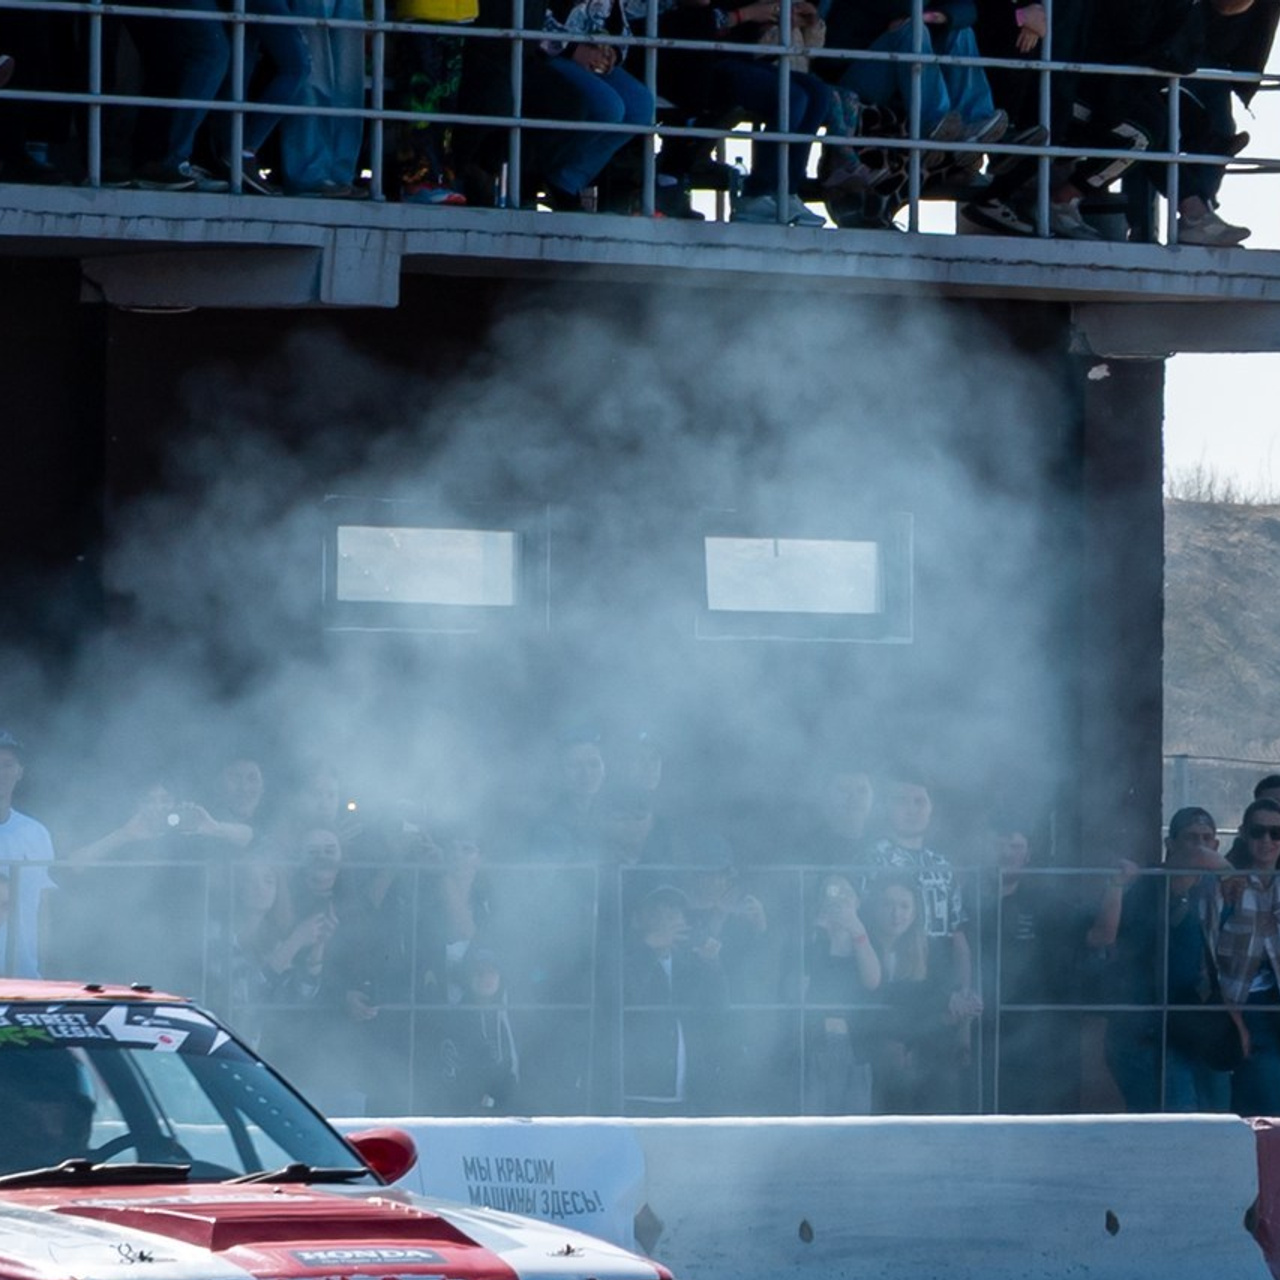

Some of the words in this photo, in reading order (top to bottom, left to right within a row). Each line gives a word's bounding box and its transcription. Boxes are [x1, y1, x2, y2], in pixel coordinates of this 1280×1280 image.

[15, 1013, 89, 1027] STREET
[47, 1025, 111, 1040] LEGAL
[462, 1156, 492, 1183] МЫ
[494, 1157, 556, 1186] КРАСИМ
[468, 1185, 537, 1214] МАШИНЫ
[541, 1189, 605, 1219] ЗДЕСЬ!
[296, 1249, 433, 1260] HONDA
